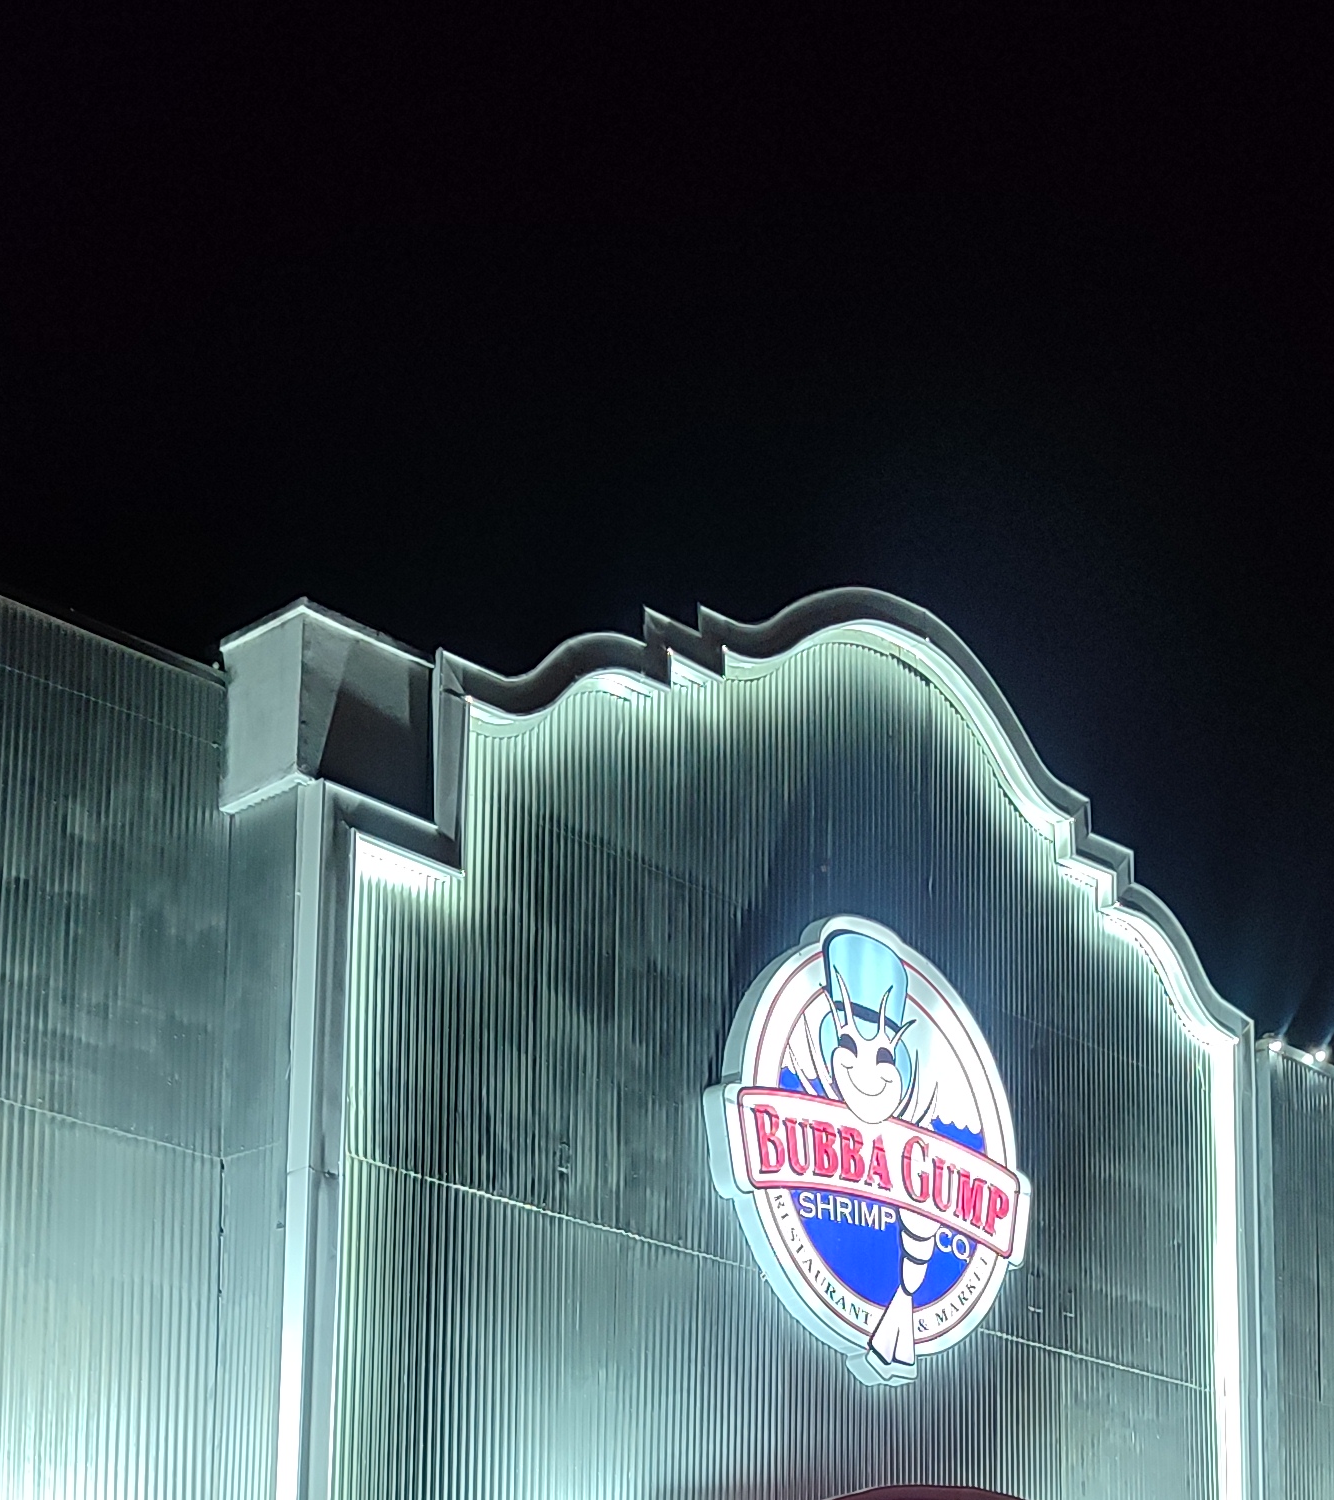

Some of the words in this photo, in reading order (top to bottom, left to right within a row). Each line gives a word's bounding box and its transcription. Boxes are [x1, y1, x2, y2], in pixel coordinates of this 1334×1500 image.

[751, 1104, 894, 1192] BUBBA
[900, 1135, 1010, 1237] GUMP
[798, 1191, 897, 1231] SHRIMP
